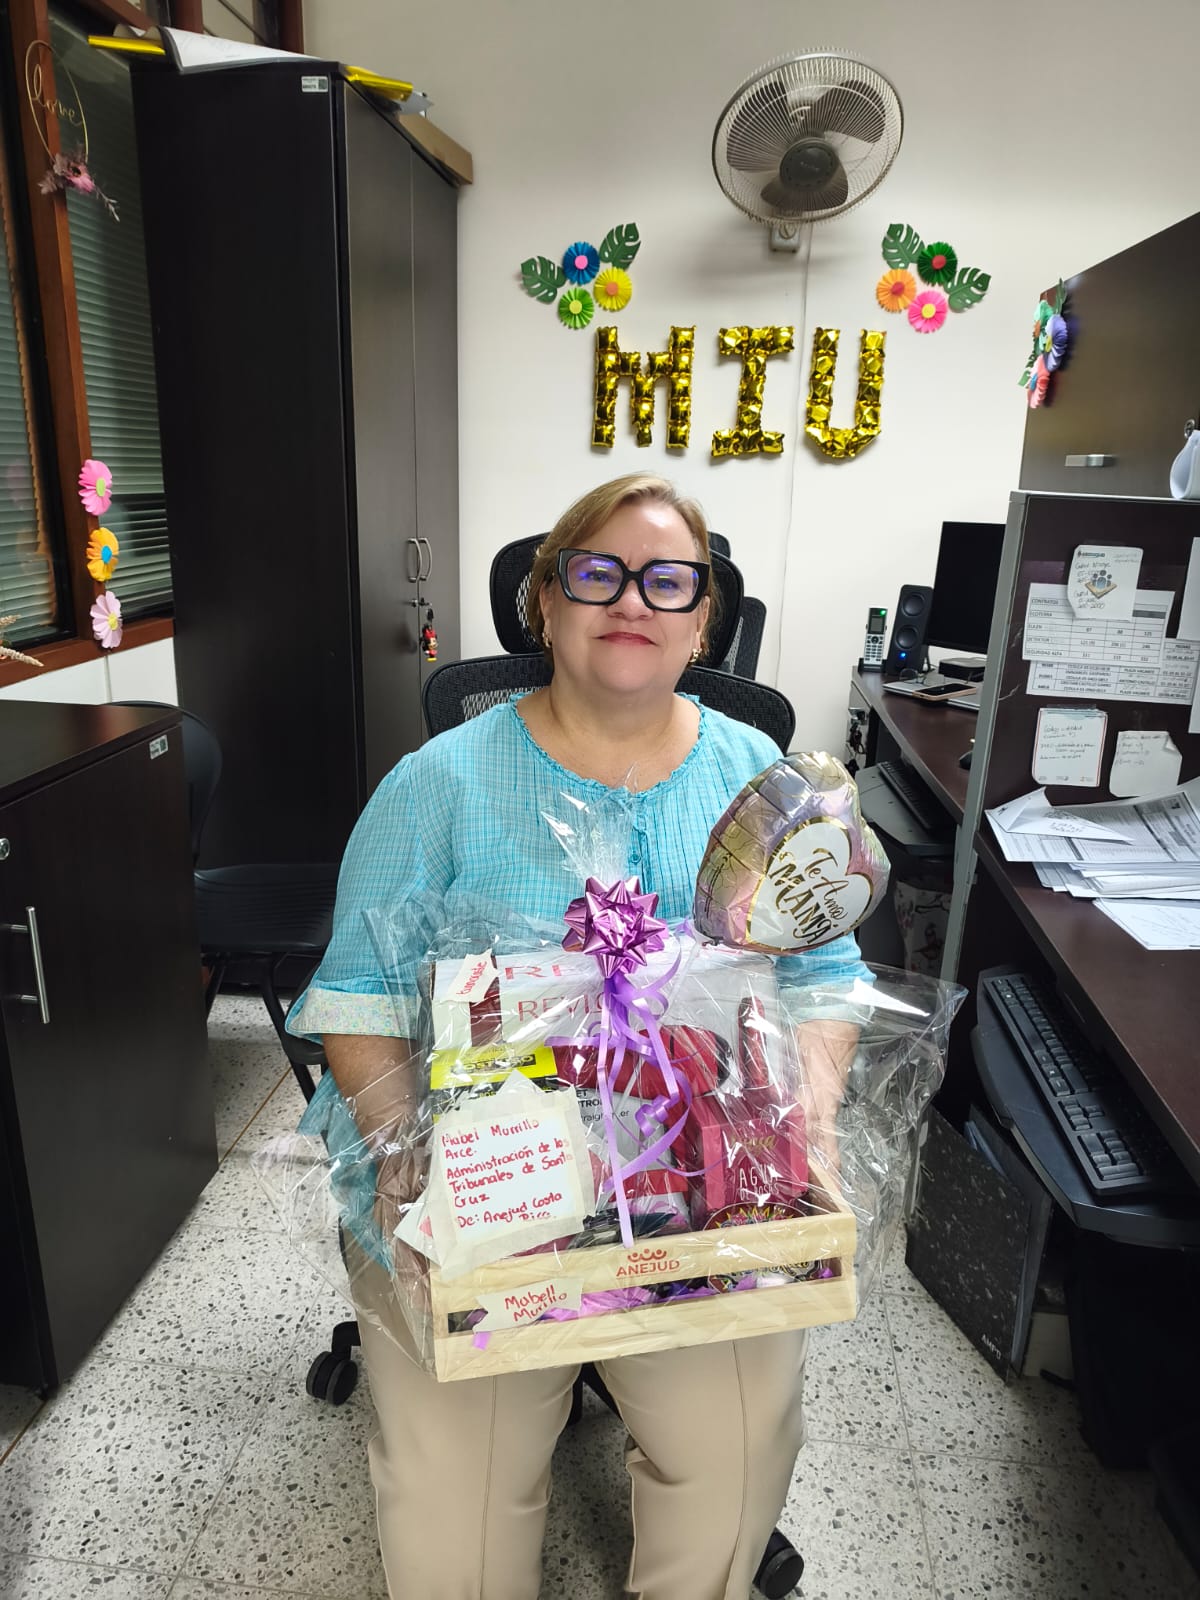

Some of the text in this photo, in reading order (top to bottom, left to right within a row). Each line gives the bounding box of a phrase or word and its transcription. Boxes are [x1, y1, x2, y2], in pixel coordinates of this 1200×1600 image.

[592, 325, 887, 458] MIU
[804, 848, 839, 878] Te
[578, 1098, 603, 1108] TRO
[446, 1145, 534, 1179] Administración
[538, 1142, 551, 1153] de
[449, 1169, 514, 1194] Tribunales
[522, 1162, 536, 1174] de
[454, 1193, 490, 1208] Cruz
[532, 1192, 562, 1209] Costa
[616, 1260, 680, 1277] ANEJUD
